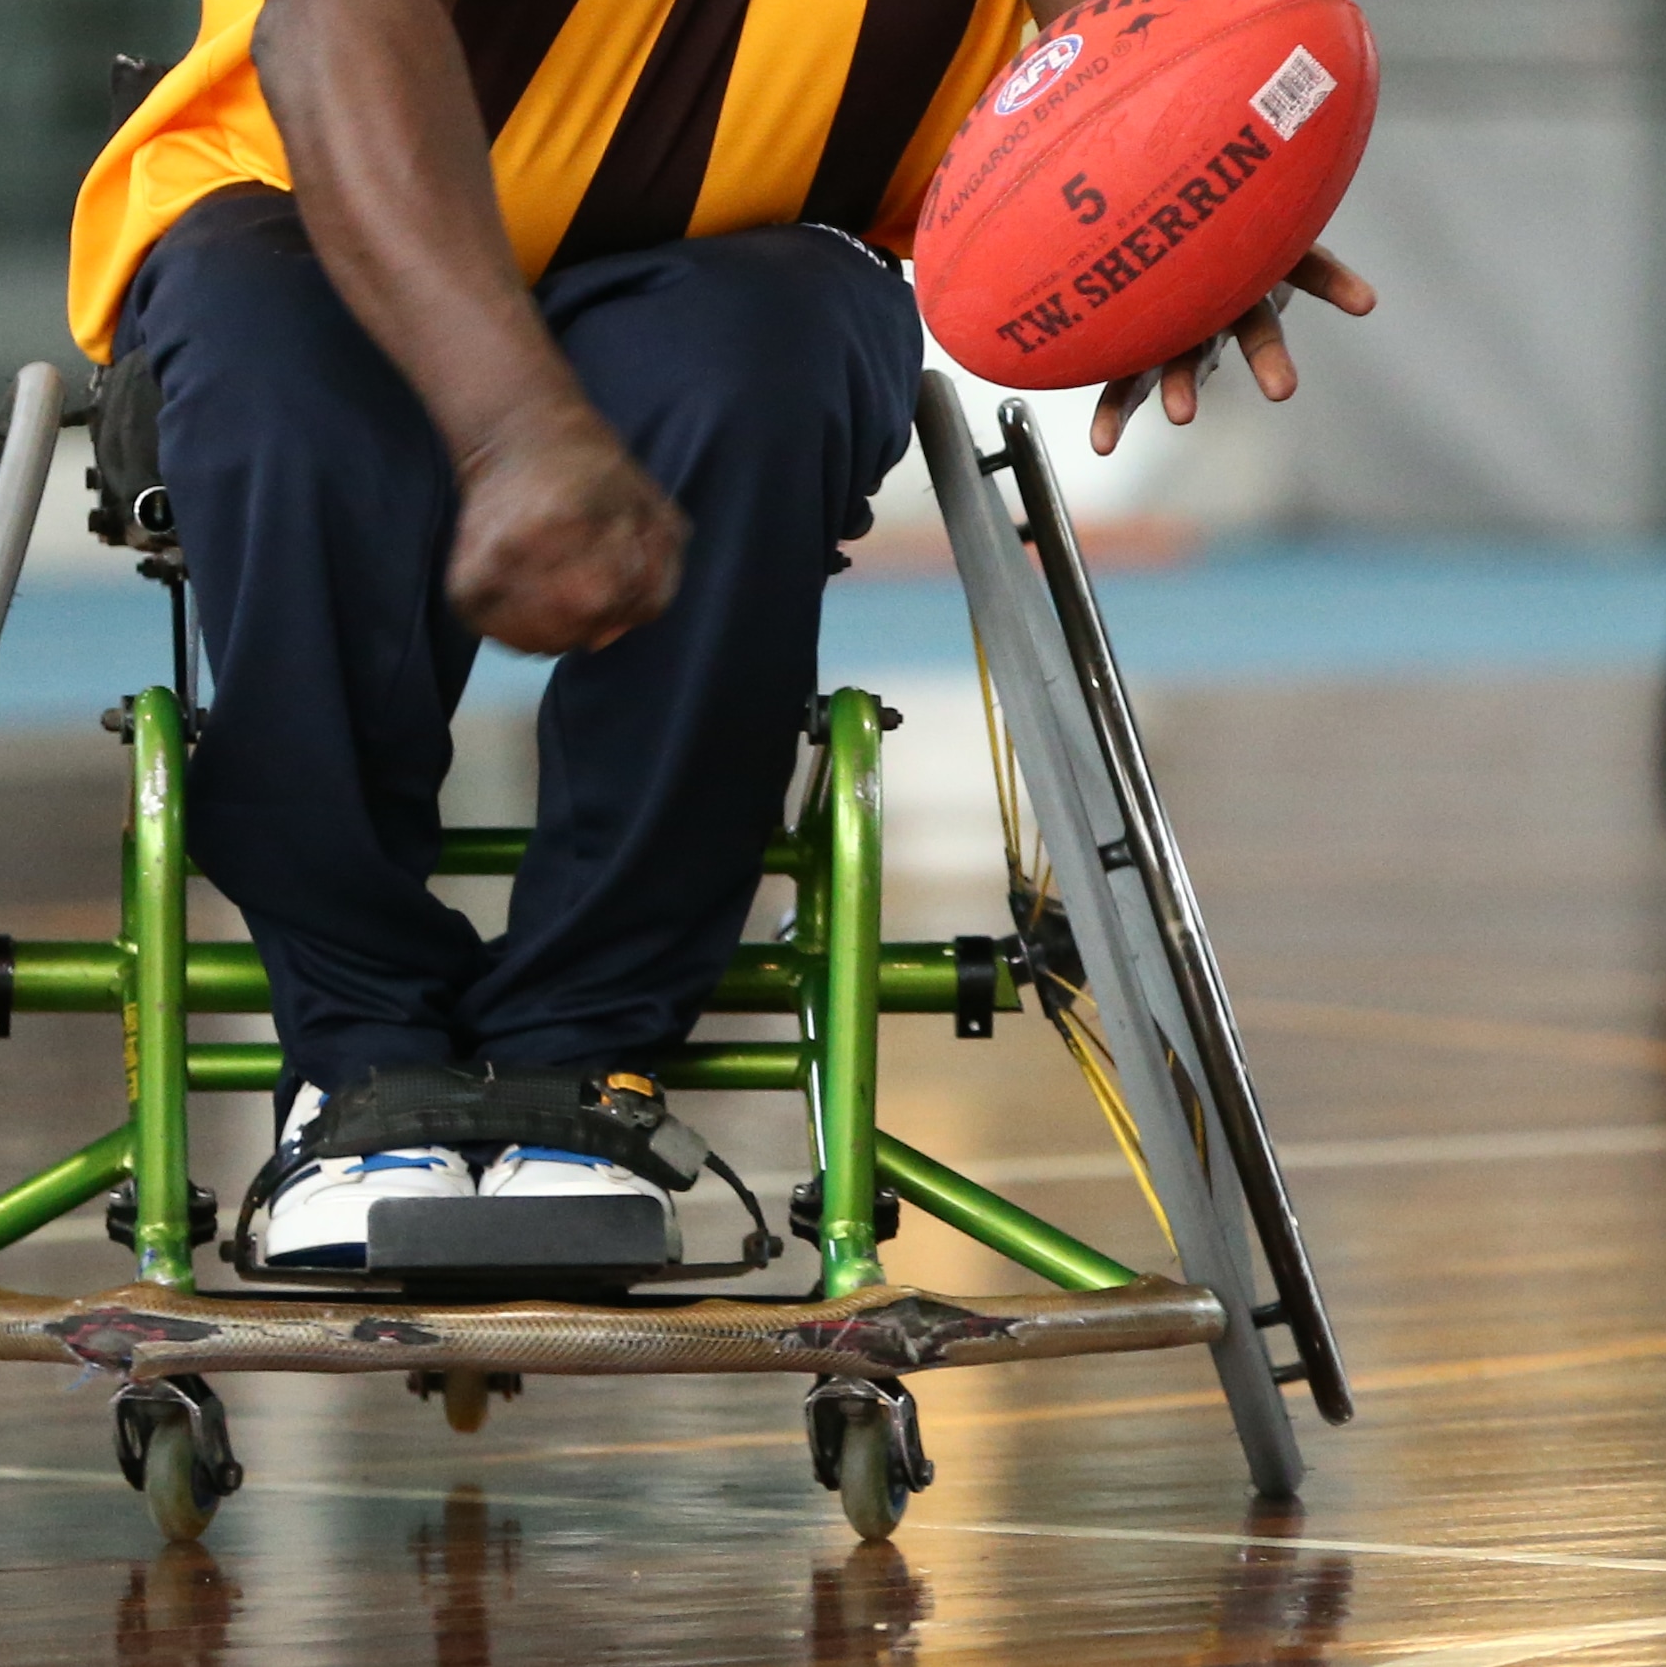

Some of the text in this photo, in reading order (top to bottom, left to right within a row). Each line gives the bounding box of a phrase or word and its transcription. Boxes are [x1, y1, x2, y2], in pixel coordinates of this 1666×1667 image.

[1004, 45, 1075, 112] AFL
[939, 119, 1031, 228] KANGAROO
[1033, 56, 1109, 123] BRAND
[1061, 171, 1108, 225] 5
[995, 291, 1084, 355] T.W.
[1073, 122, 1274, 311] SHERRIN
